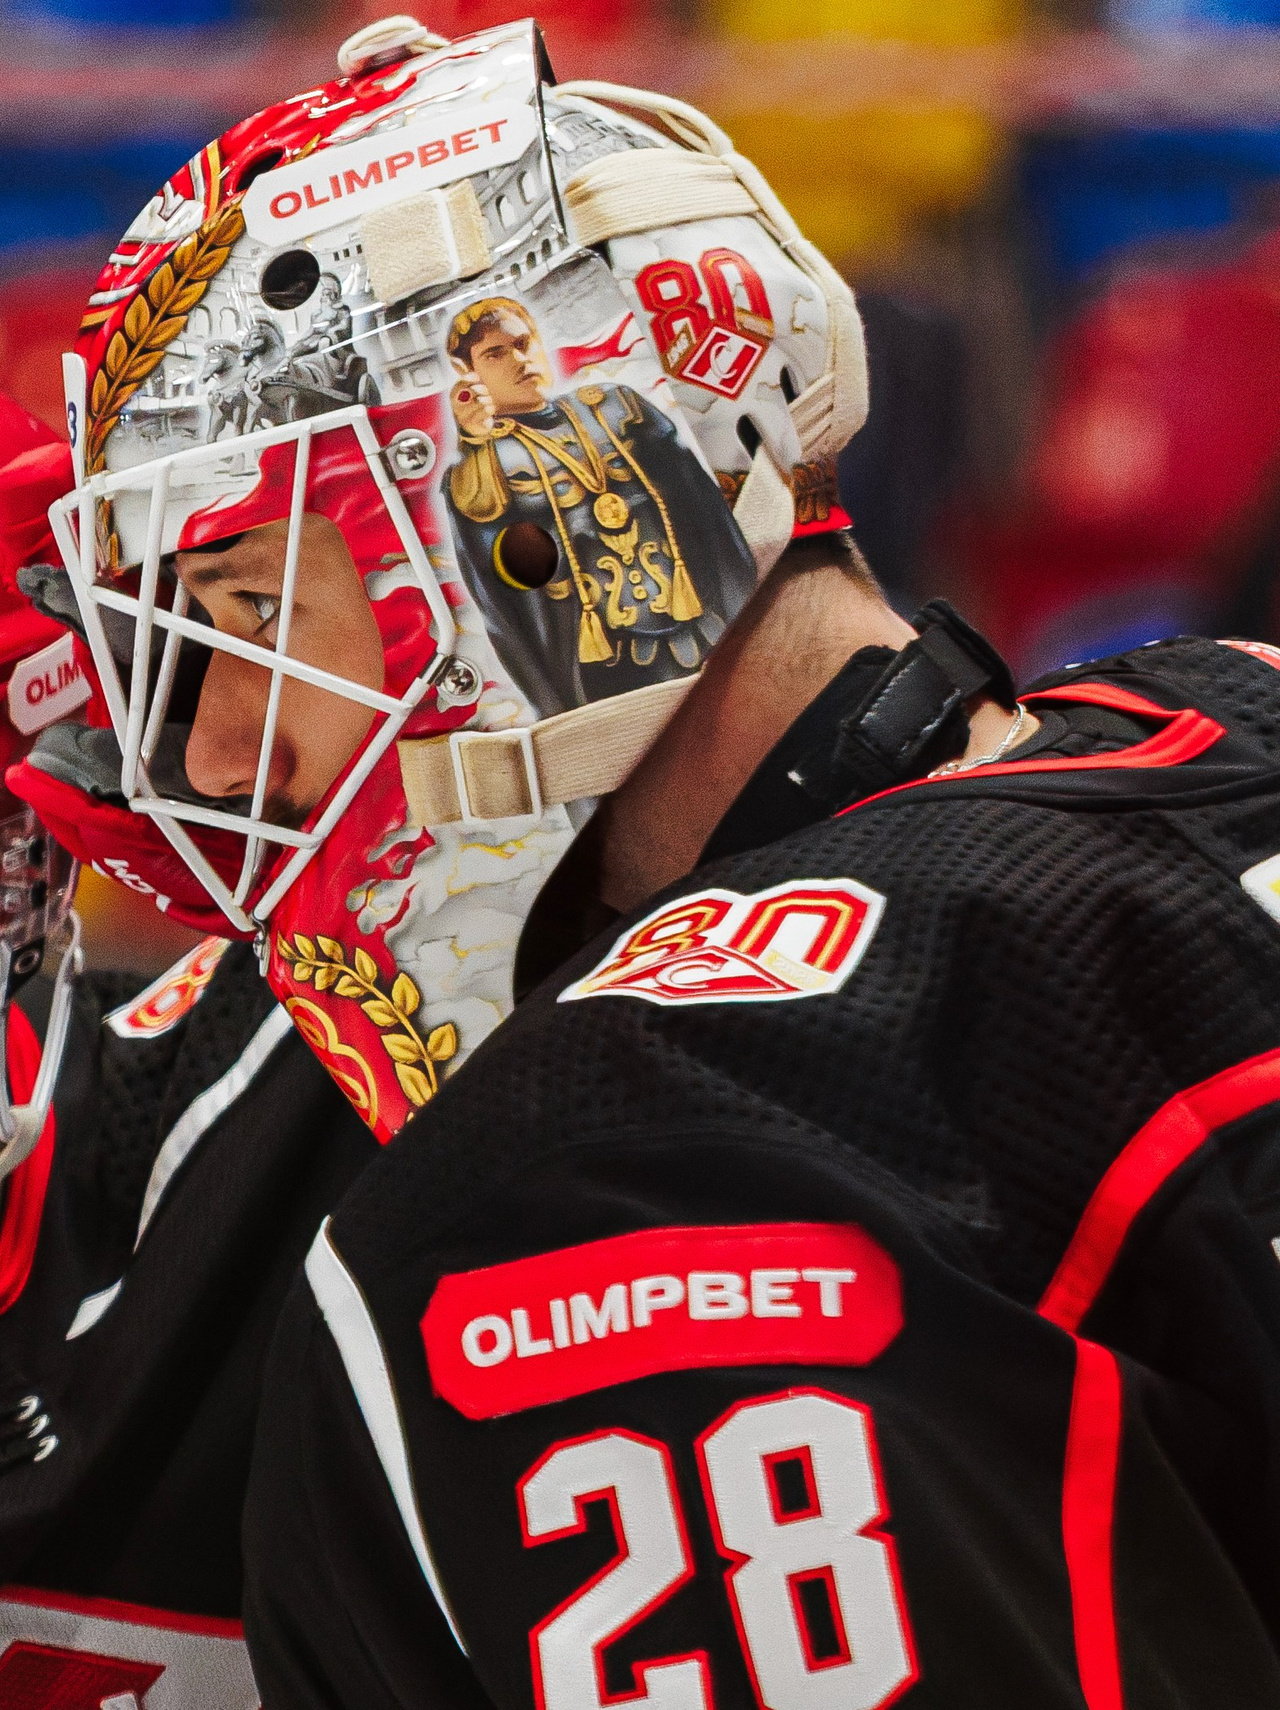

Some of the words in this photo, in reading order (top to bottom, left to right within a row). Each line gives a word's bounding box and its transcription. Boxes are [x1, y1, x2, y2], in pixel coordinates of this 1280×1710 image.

[269, 118, 509, 220] OLIMPBET
[460, 1267, 858, 1368] OLIMPBET
[516, 1386, 920, 1710] 28
